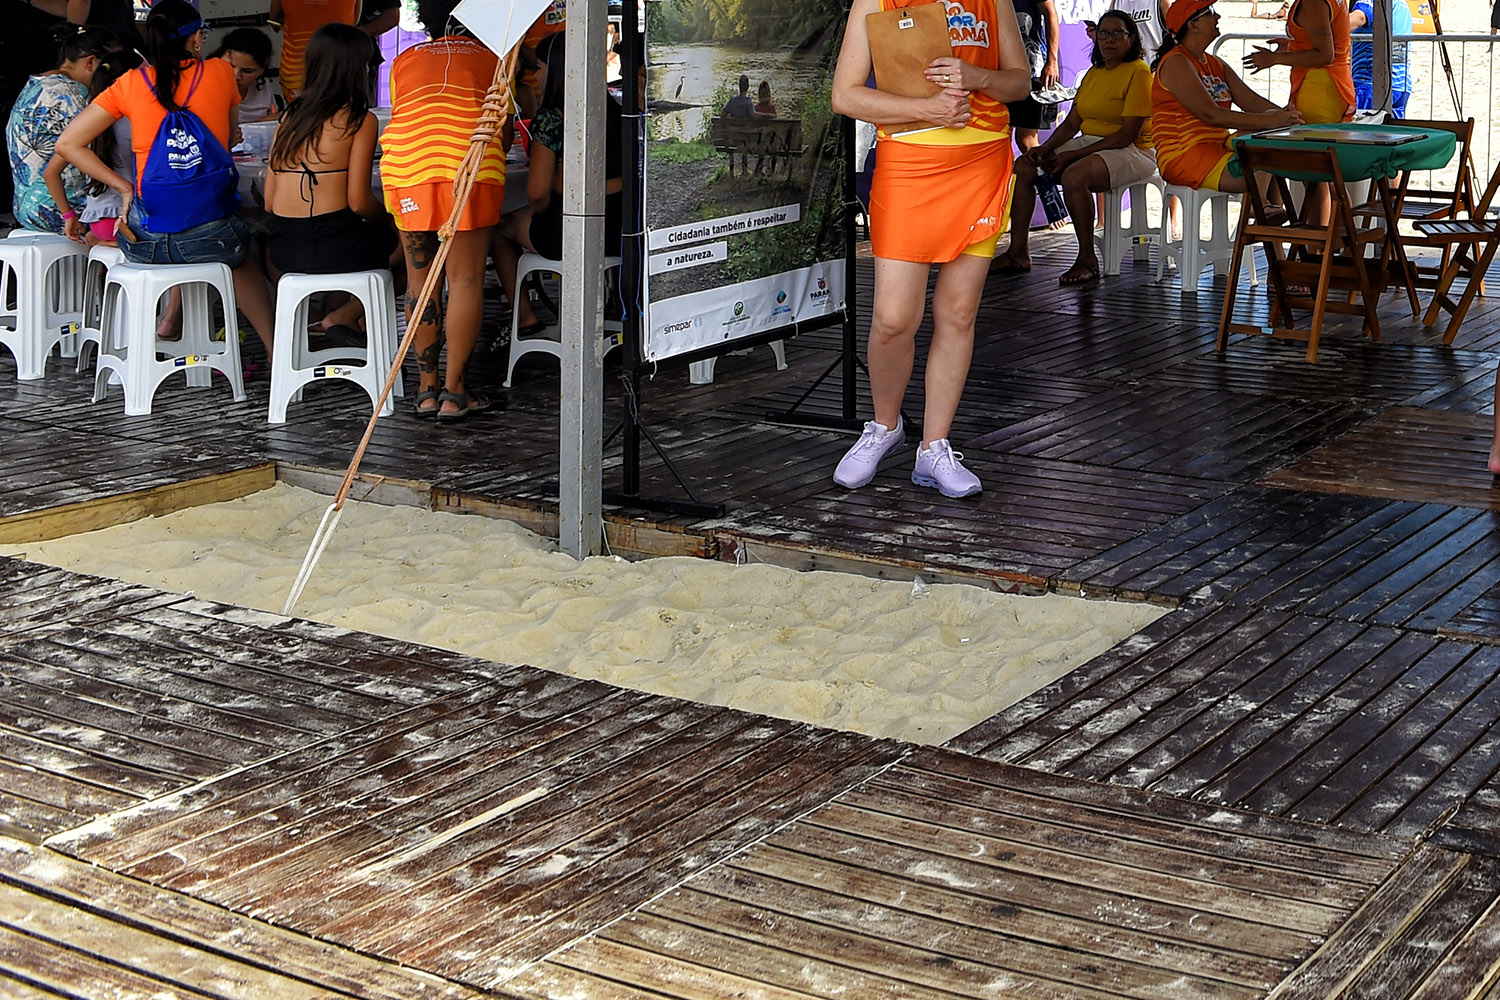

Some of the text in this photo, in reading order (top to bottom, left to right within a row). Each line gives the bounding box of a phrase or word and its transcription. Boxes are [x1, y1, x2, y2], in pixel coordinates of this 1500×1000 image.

[668, 212, 787, 243] Cidadania também é respeitar
[666, 249, 714, 266] a natureza.
[663, 318, 692, 335] simepar
